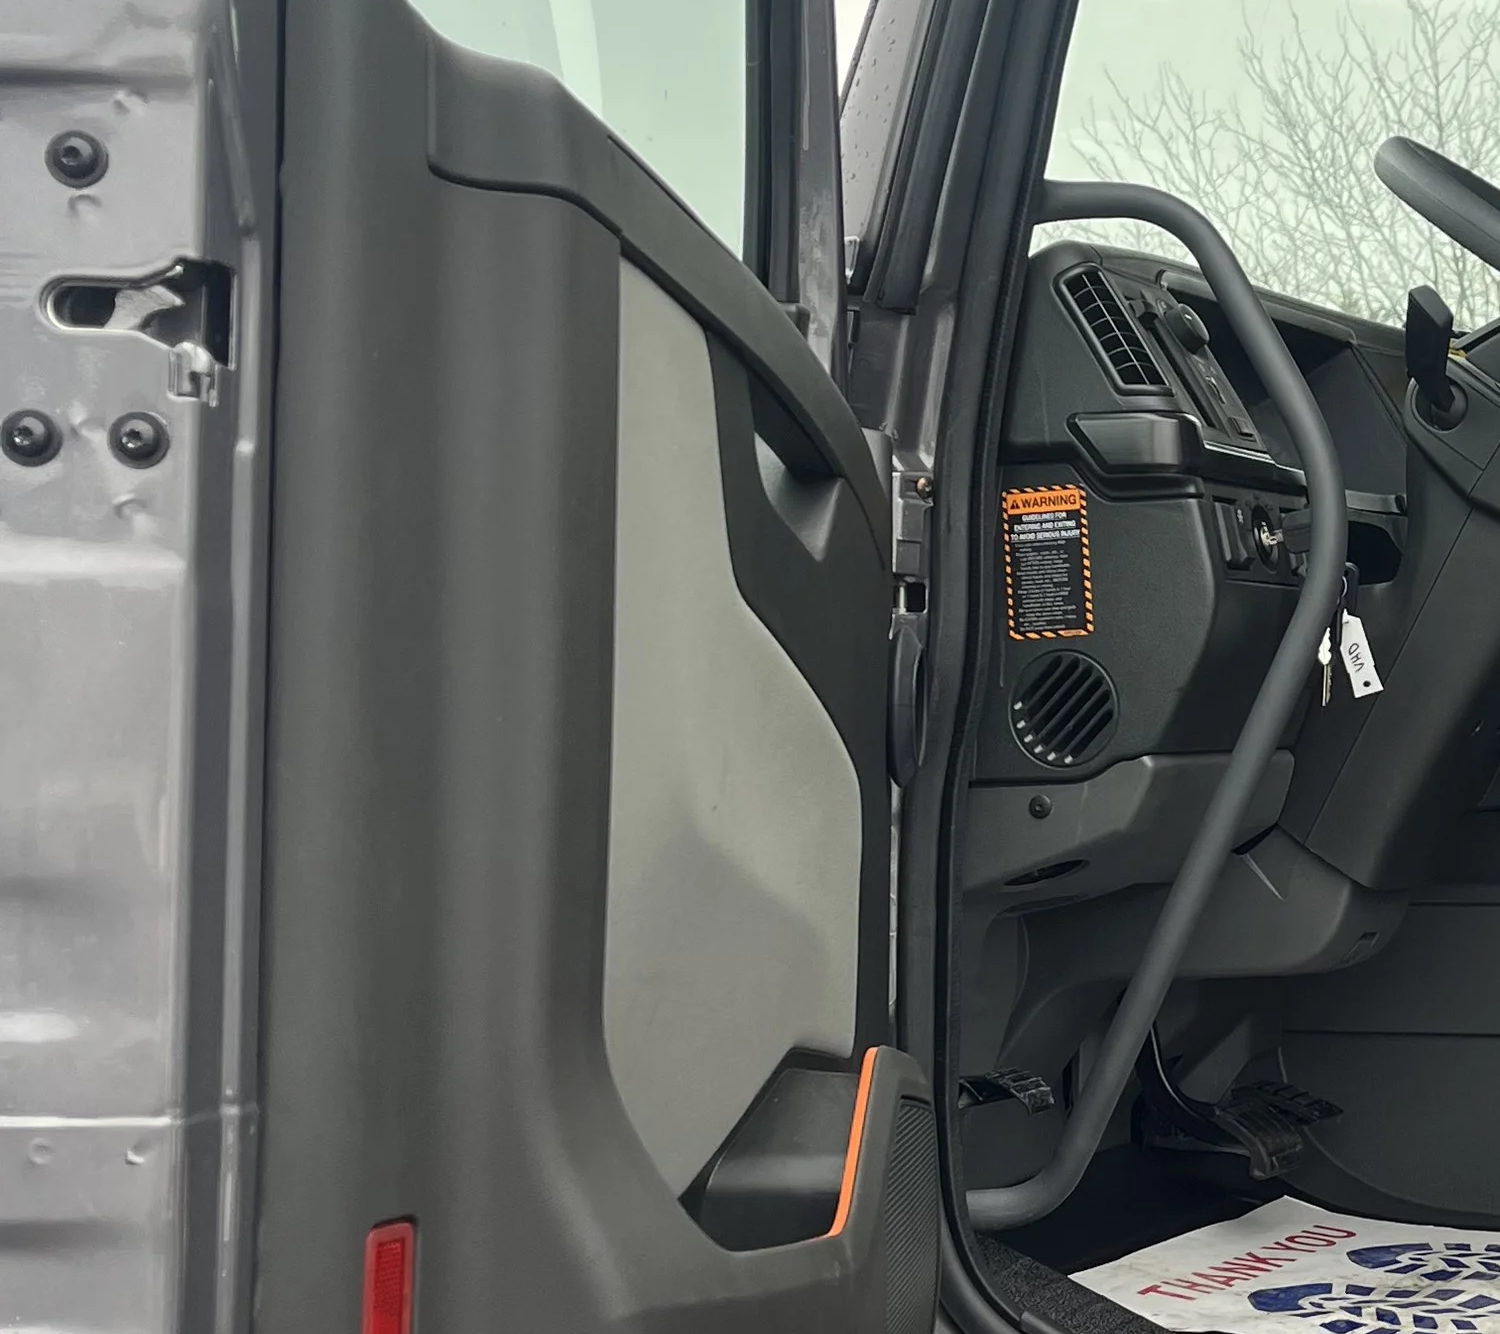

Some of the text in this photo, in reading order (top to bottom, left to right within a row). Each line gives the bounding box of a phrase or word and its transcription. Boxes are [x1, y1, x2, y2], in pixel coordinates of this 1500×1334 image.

[1021, 495, 1076, 508] WARNING
[1137, 1224, 1357, 1301] THANK YOU
